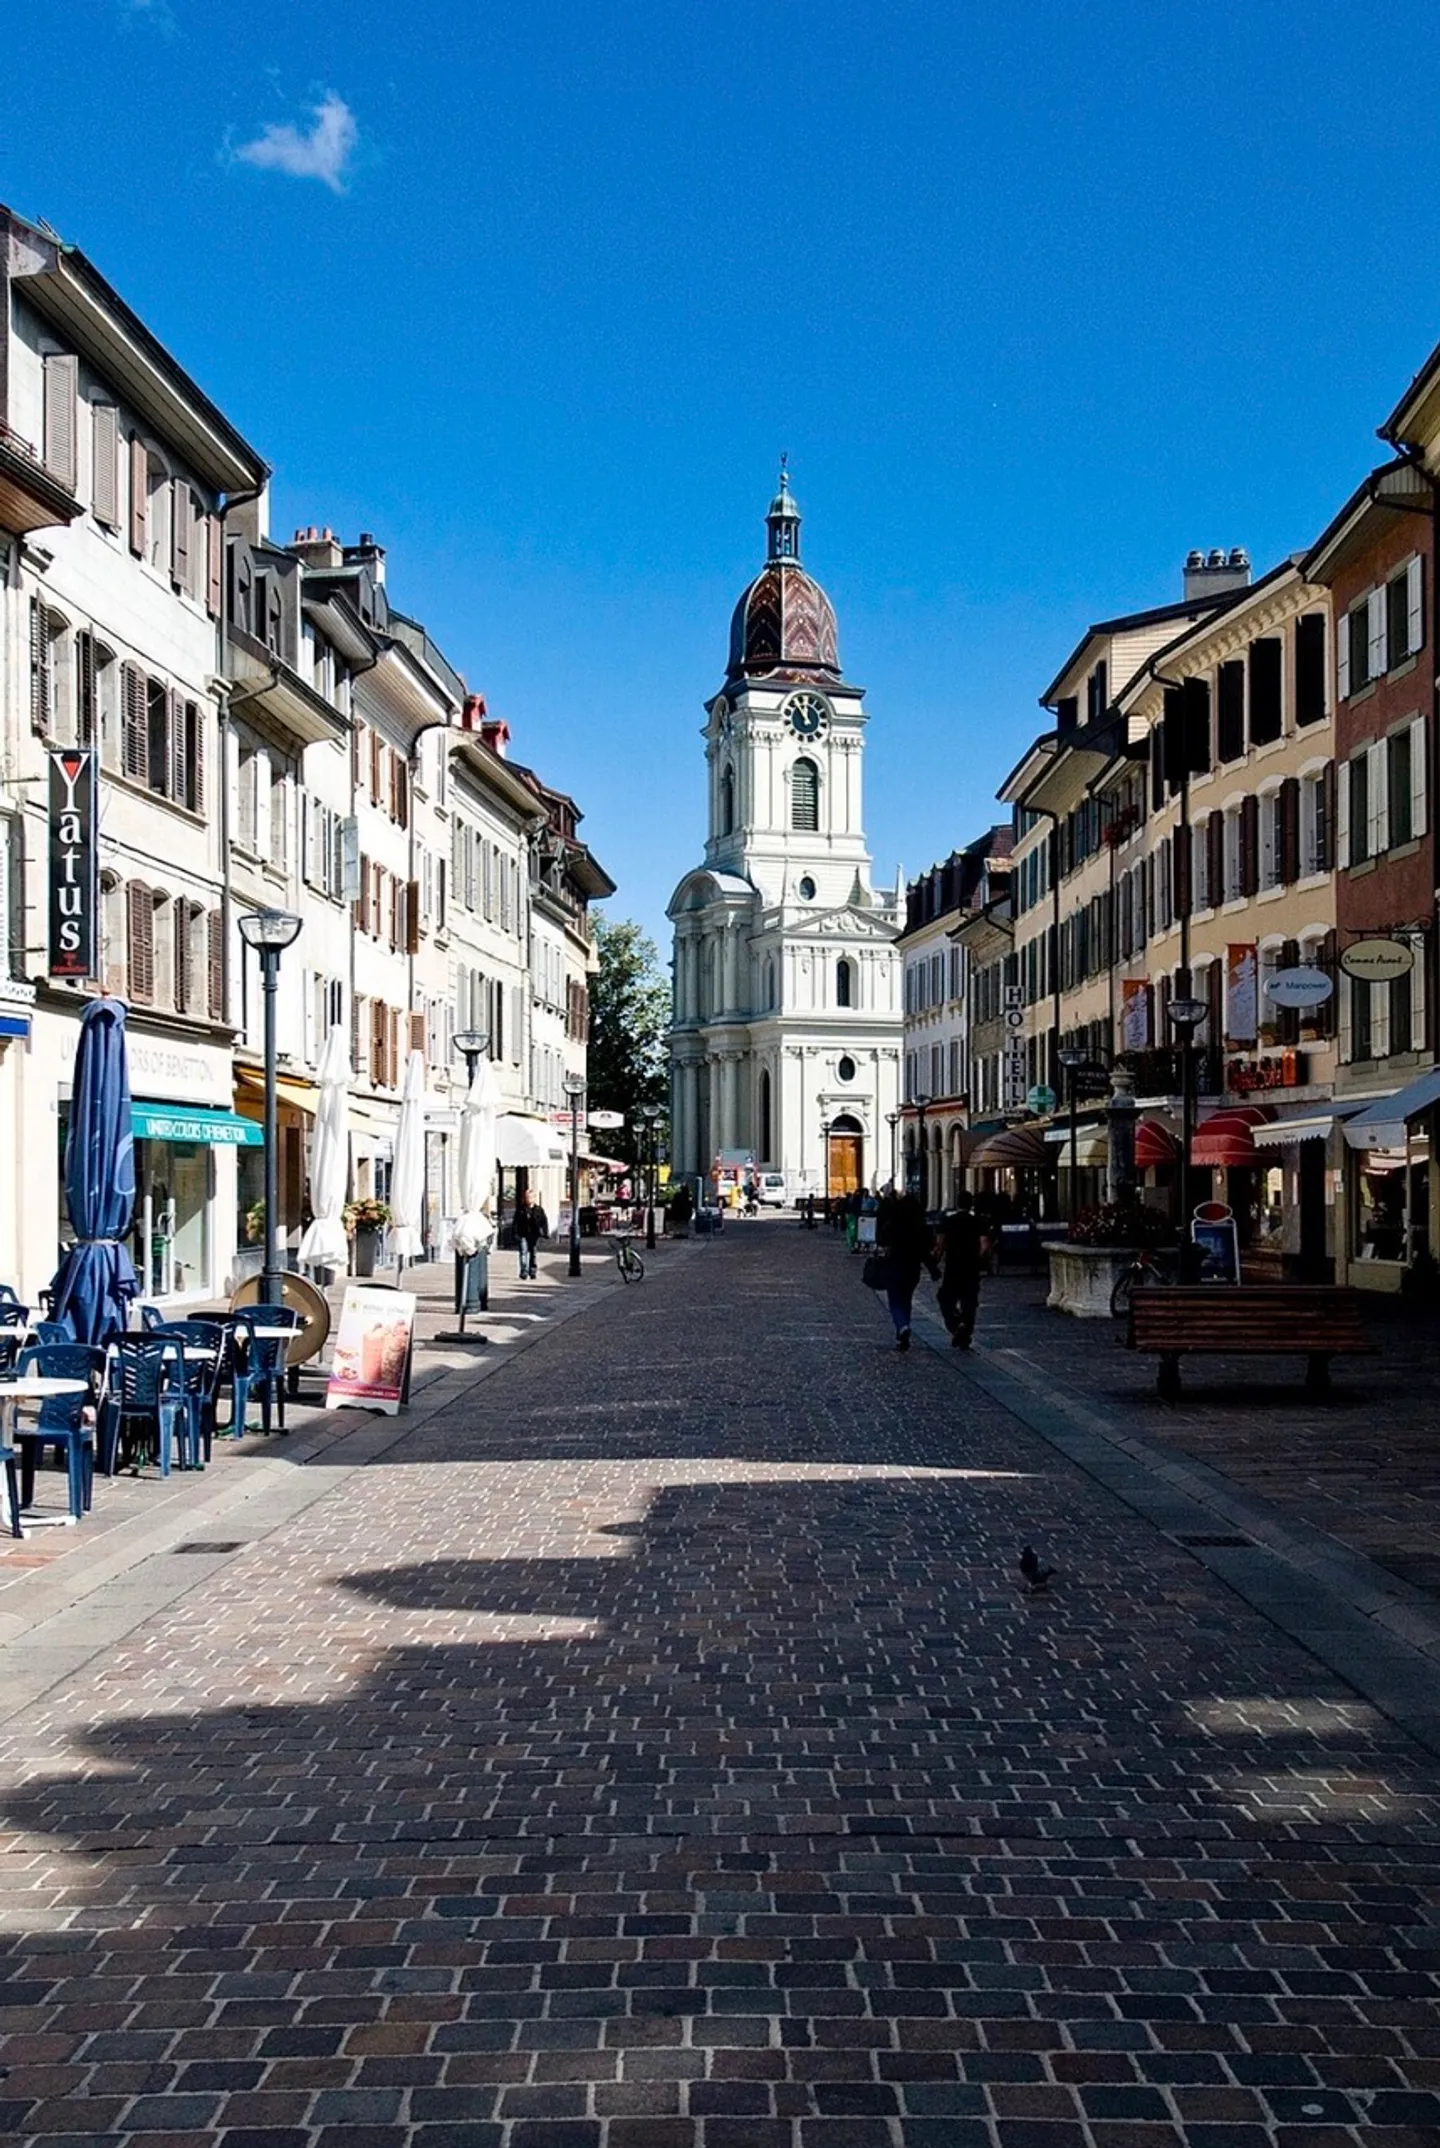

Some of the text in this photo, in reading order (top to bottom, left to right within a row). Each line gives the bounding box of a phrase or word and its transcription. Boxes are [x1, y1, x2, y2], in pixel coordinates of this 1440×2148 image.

[50, 752, 89, 951] Yatus
[1285, 981, 1328, 990] Manpower
[1008, 987, 1024, 1099] HOTEL
